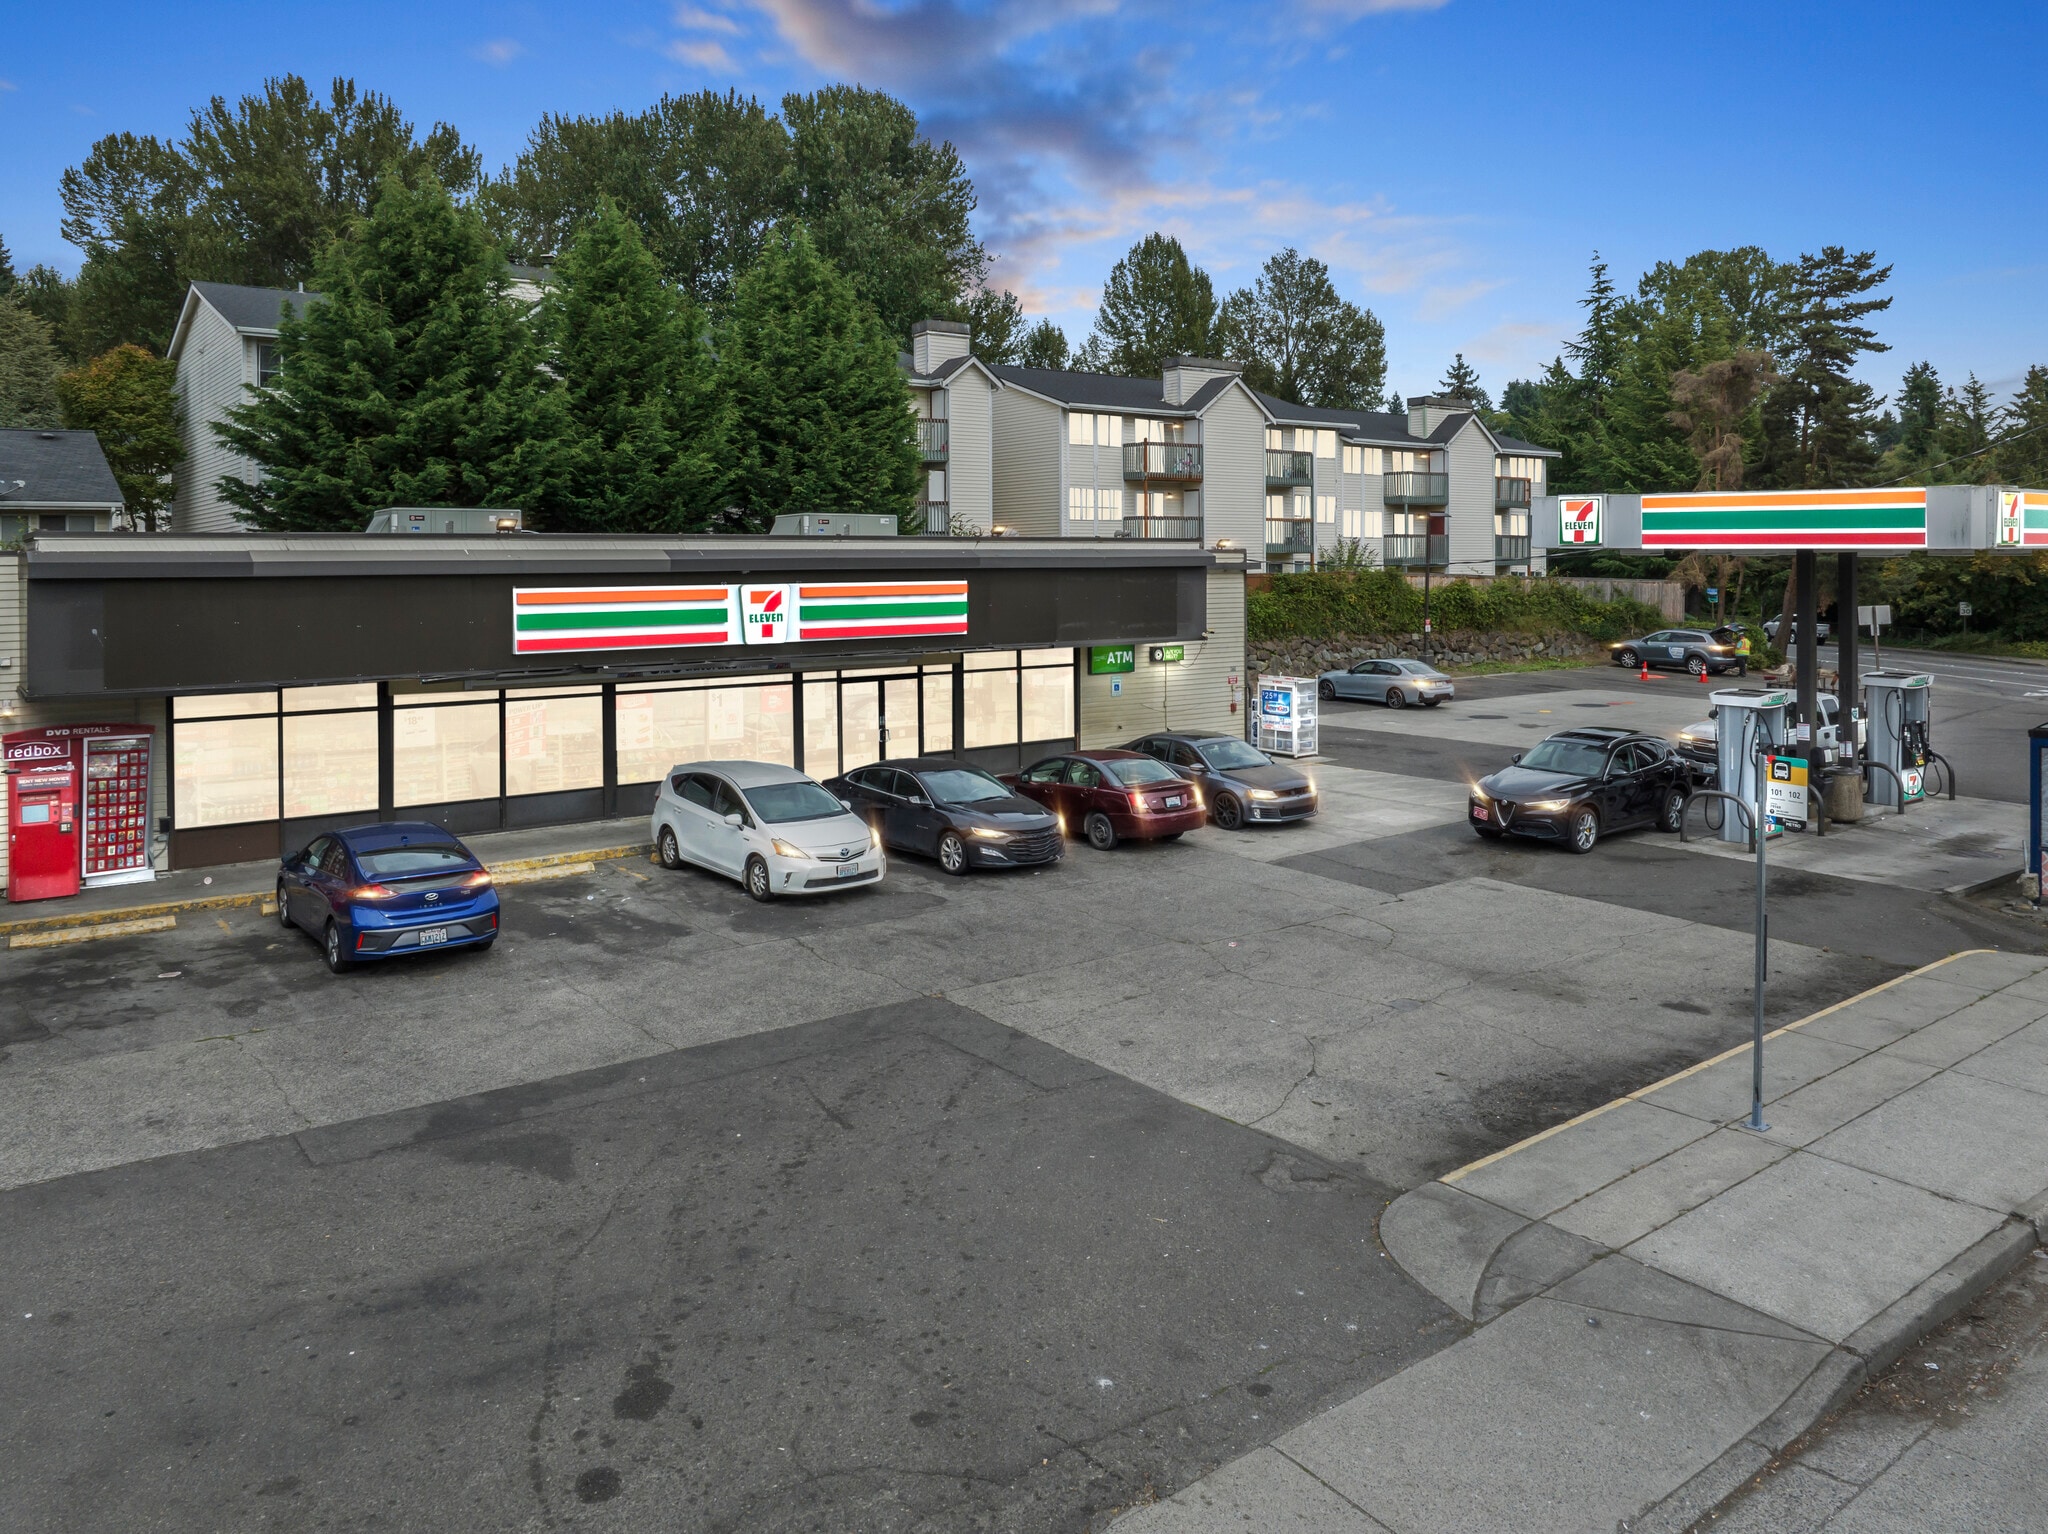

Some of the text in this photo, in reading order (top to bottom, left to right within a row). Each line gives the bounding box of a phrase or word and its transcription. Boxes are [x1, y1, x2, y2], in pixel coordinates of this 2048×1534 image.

[1566, 501, 1593, 542] 7
[750, 591, 782, 638] 7
[1107, 651, 1133, 664] ATM
[46, 726, 111, 737] DVD RENTALS
[8, 745, 62, 758] redbox
[1771, 788, 1782, 796] 101
[1789, 791, 1801, 800] 102
